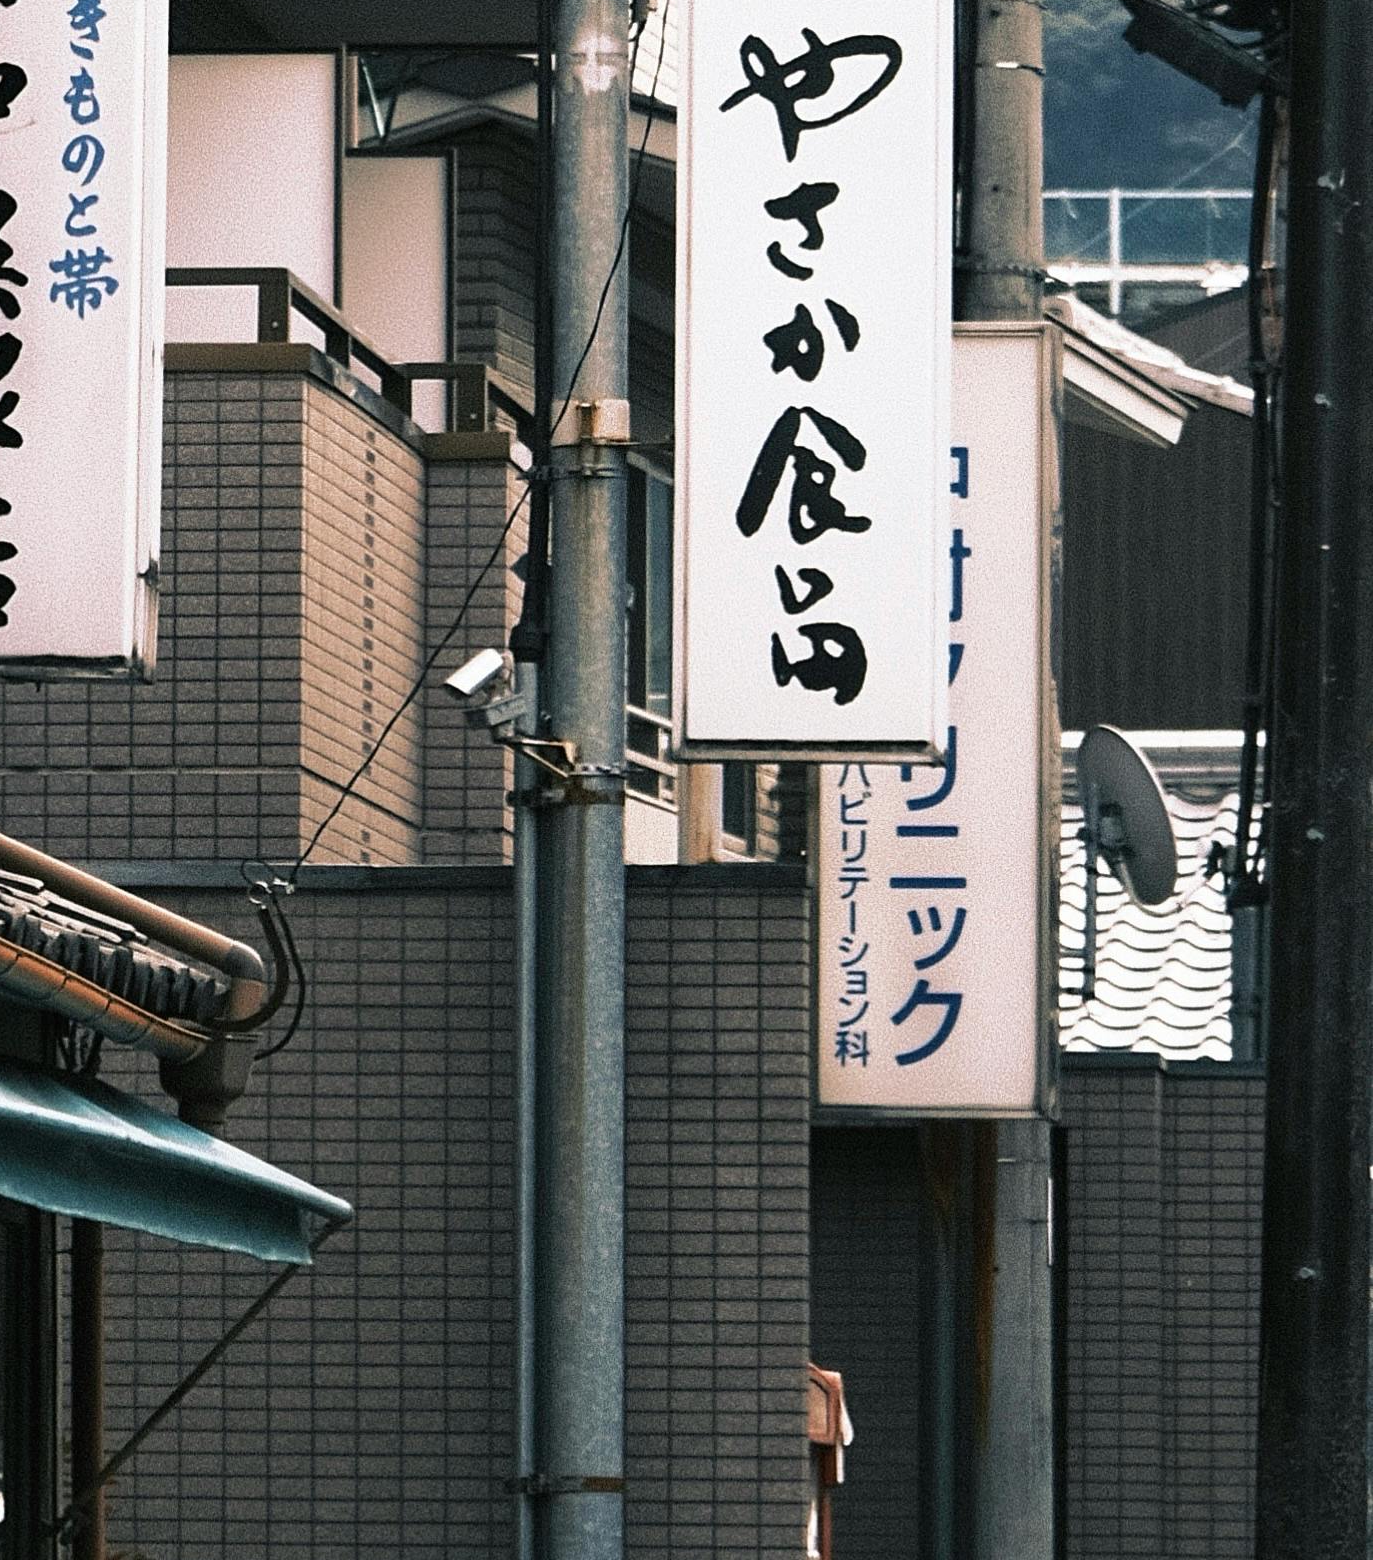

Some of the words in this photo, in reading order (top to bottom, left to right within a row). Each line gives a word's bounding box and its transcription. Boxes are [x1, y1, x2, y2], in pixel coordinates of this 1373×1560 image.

[719, 27, 903, 706] やさか食品
[889, 446, 970, 1065] リニック
